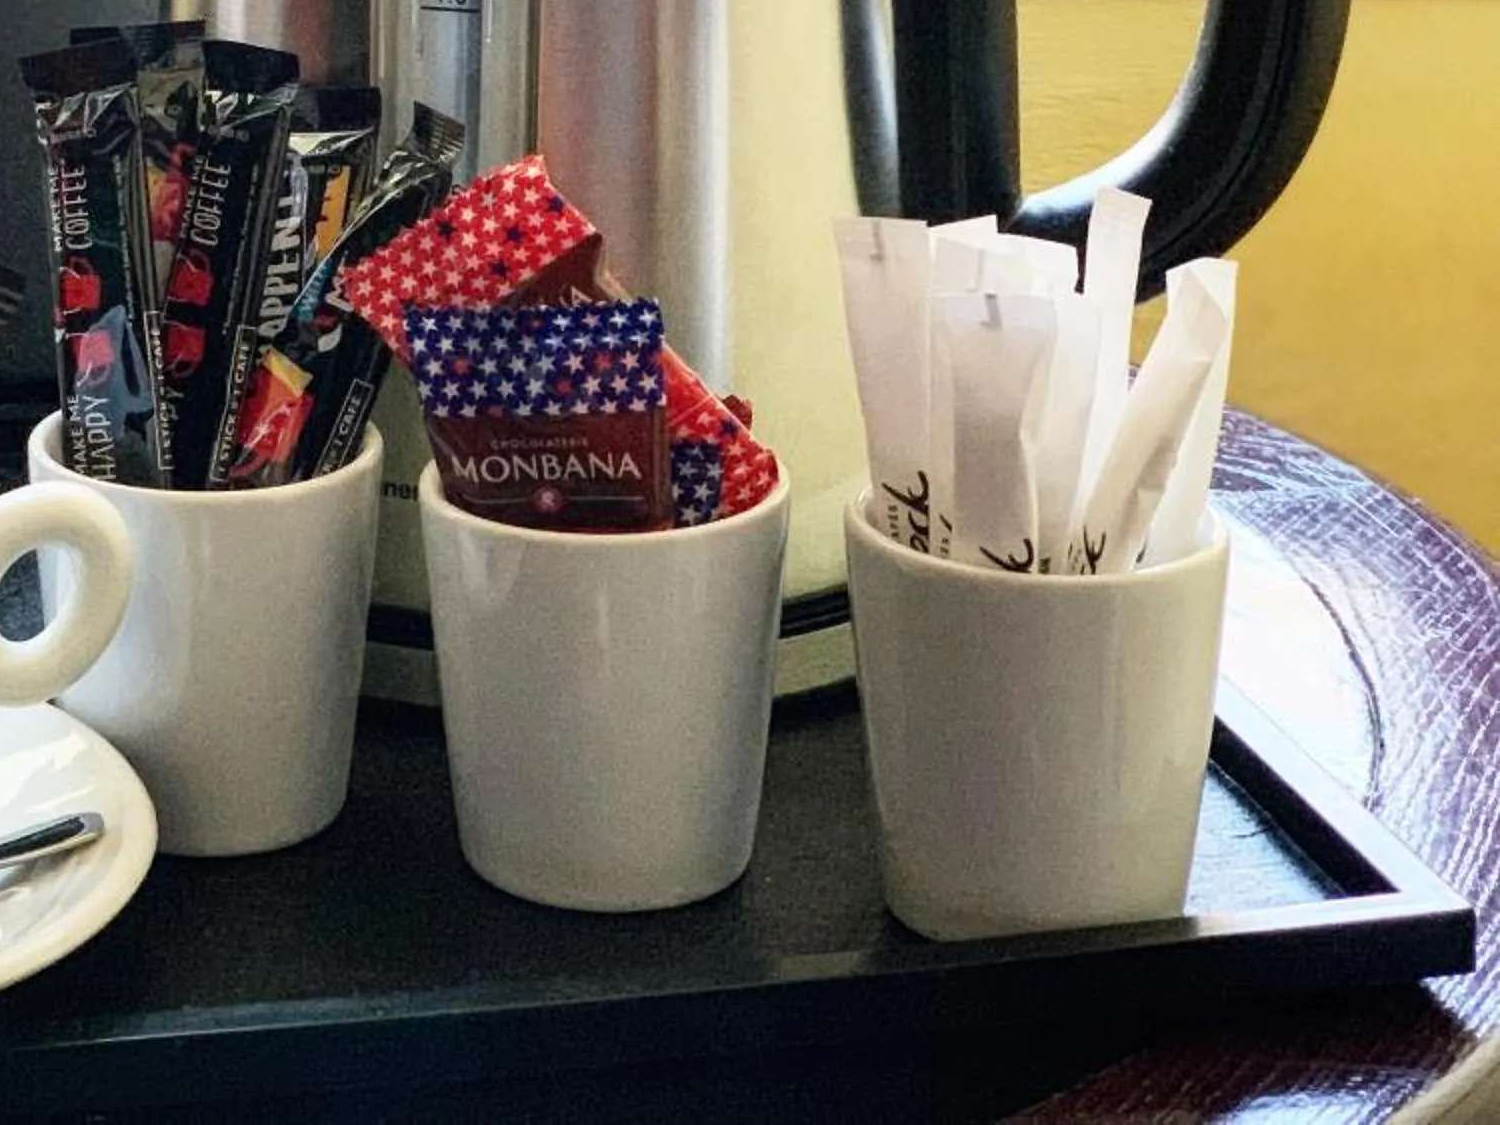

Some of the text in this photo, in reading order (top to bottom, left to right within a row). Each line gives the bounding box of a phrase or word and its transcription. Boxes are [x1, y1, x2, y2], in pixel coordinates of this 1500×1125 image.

[60, 163, 94, 251] COFFEE
[189, 159, 233, 248] COFFEE
[68, 394, 88, 476] MAKE ME
[82, 394, 118, 481] HAPPY
[451, 451, 644, 484] MONBANA
